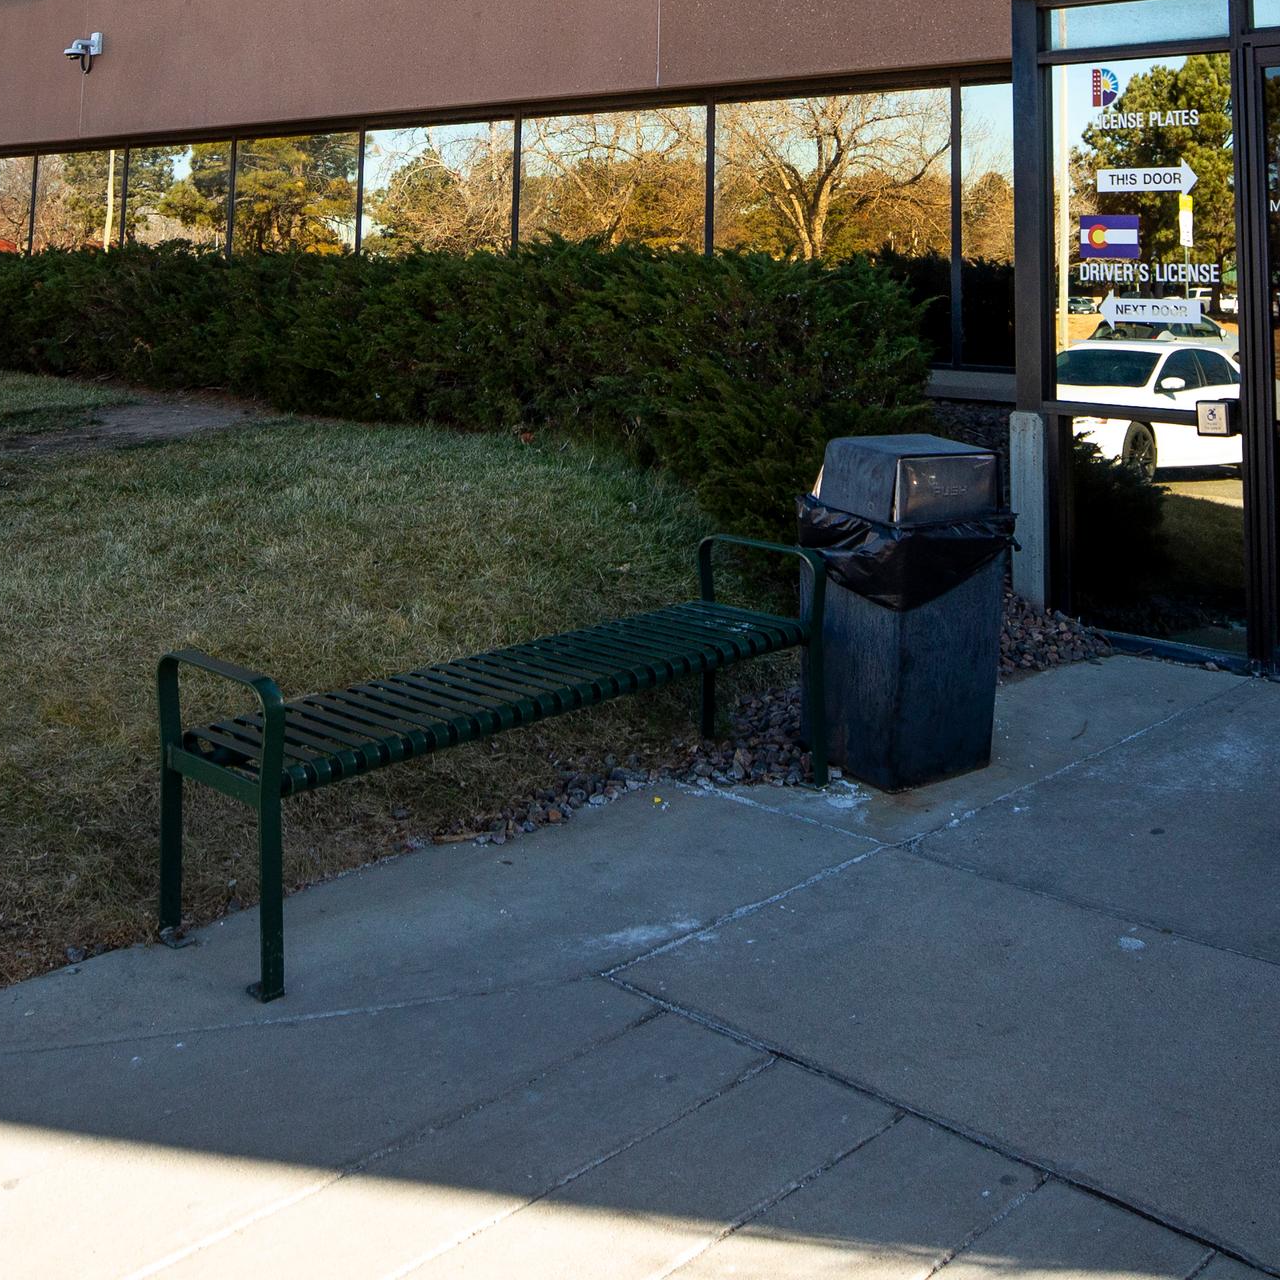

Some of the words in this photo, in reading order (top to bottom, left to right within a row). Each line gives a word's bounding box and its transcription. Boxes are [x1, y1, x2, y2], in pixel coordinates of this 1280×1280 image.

[1149, 109, 1199, 127] PLATES
[1108, 173, 1137, 186] THIS
[1143, 172, 1182, 185] DOOR
[1079, 263, 1149, 282] DRIVER'S
[1156, 263, 1220, 283] LICENSE
[1115, 304, 1147, 316] NEXT
[1151, 304, 1188, 318] DOOR
